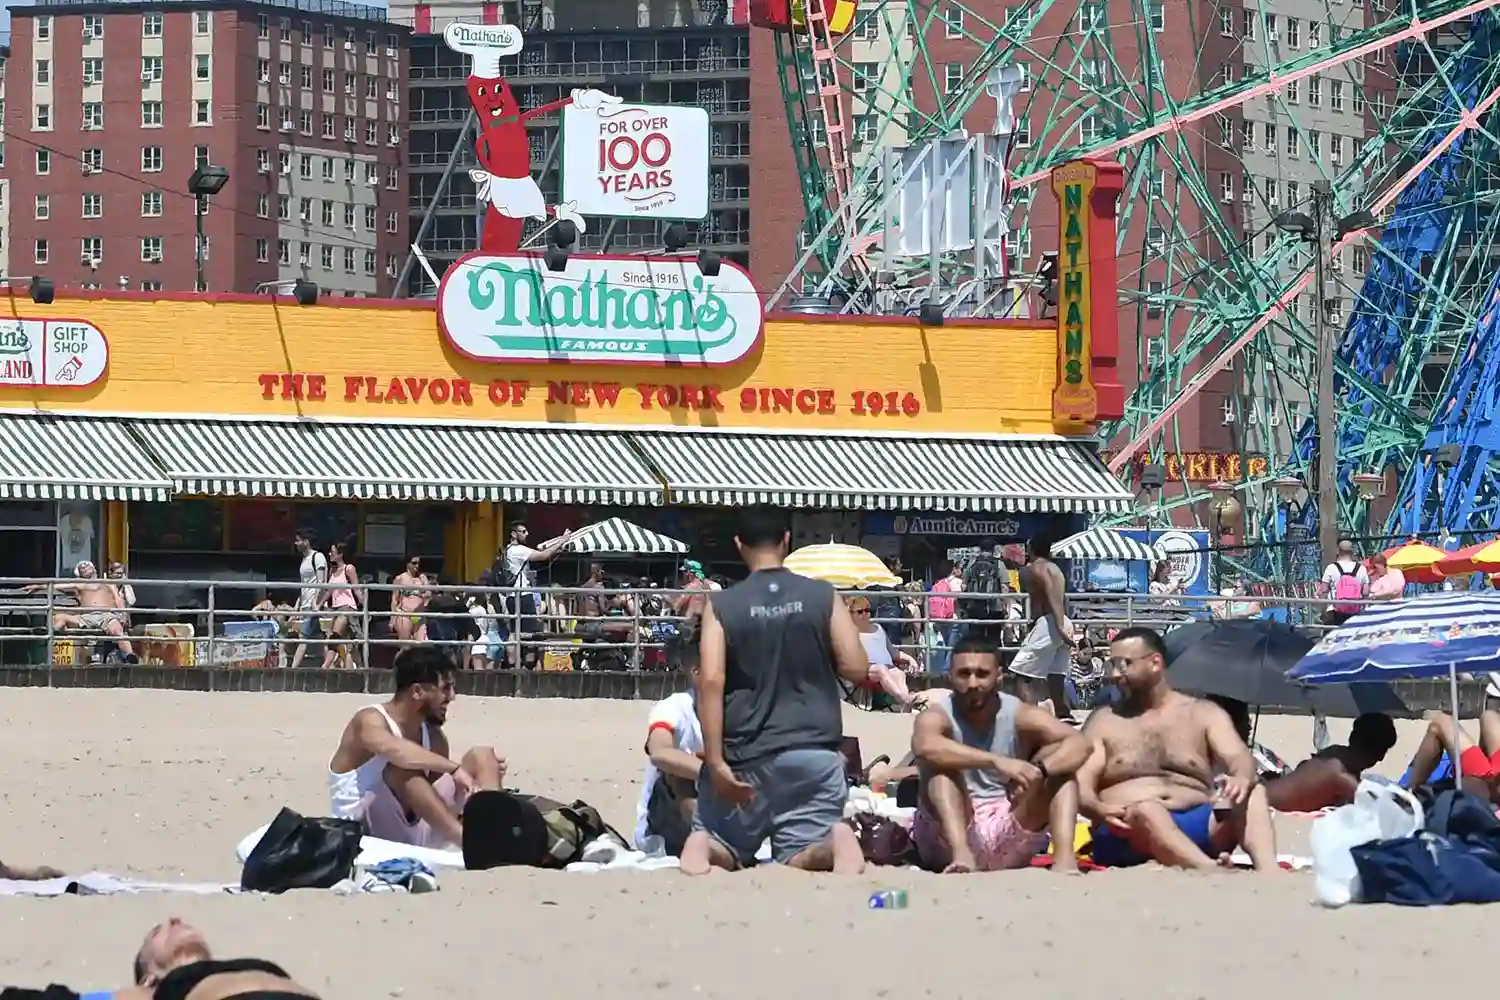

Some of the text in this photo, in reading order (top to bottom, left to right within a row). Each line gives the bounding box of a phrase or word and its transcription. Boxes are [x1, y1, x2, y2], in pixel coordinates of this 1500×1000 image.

[453, 26, 512, 44] Nathan's
[600, 117, 668, 135] FOR OVER
[599, 132, 671, 172] 100
[598, 169, 673, 194] YEARS
[622, 271, 680, 285] Since 1916
[1064, 184, 1083, 385] NATHANS
[466, 262, 728, 333] Nathan's
[53, 326, 89, 342] GIFT
[53, 341, 89, 354] SHOP
[560, 340, 649, 352] FAMOUS
[258, 373, 921, 418] THE FLAVOR OF NEW YORK SINCE 1916
